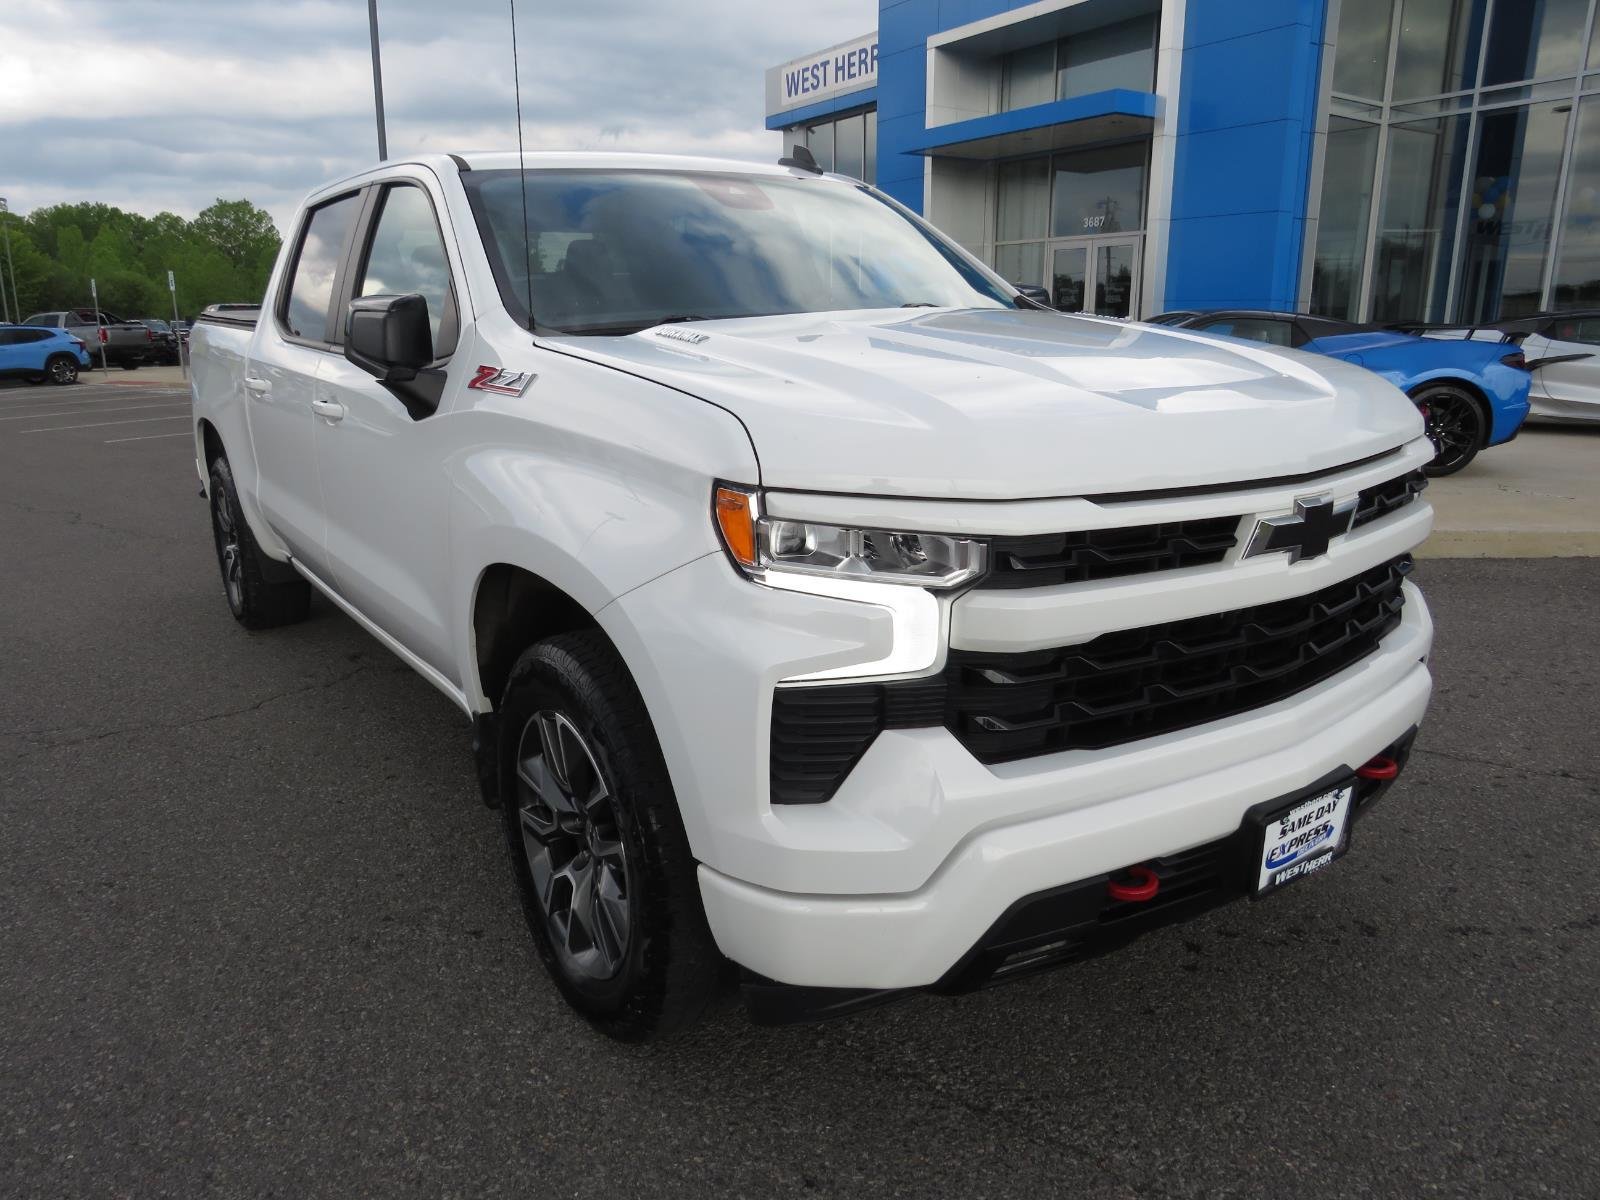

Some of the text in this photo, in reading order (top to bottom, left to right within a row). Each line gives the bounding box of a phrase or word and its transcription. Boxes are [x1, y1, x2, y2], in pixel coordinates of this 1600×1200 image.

[785, 60, 830, 98] WEST
[1083, 216, 1105, 228] 3687
[468, 365, 537, 398] Z71
[1279, 800, 1339, 840] SAME DAY
[1269, 820, 1331, 861] EXPRESS
